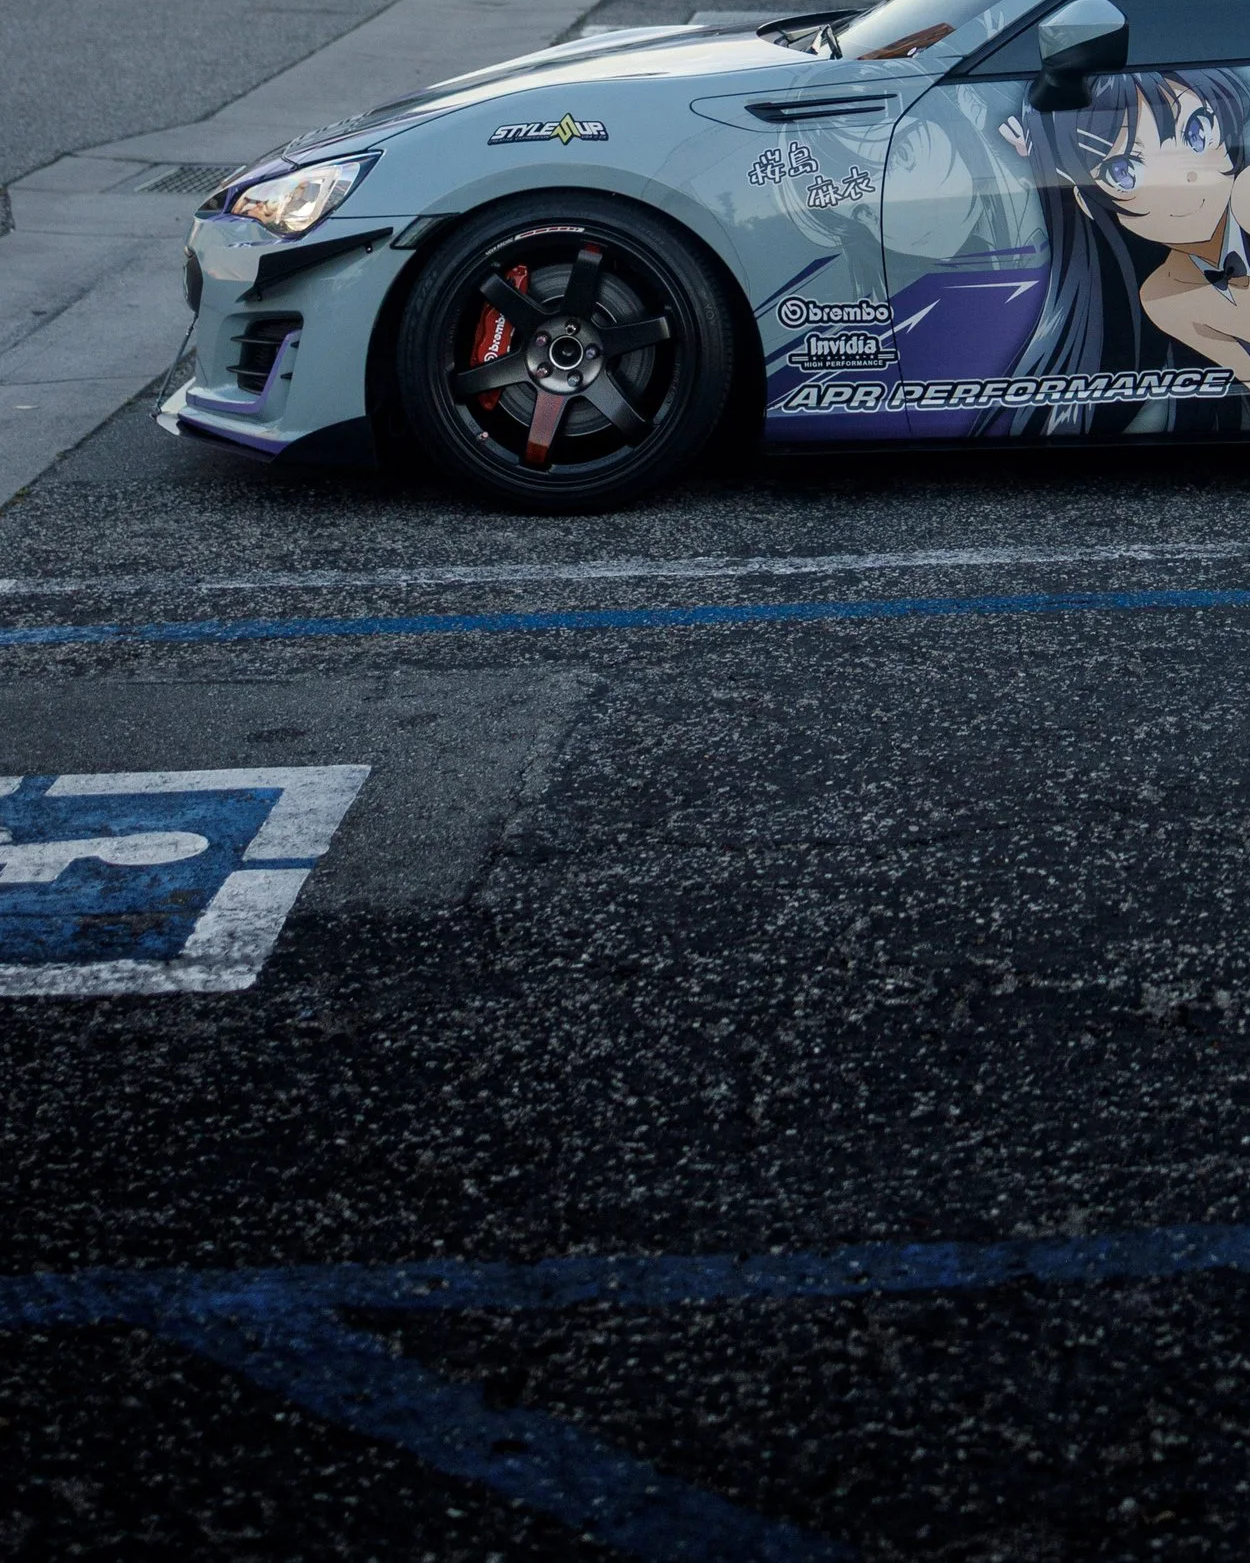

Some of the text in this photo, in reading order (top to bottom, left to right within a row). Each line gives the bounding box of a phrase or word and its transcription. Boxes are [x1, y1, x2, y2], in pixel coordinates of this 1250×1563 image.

[490, 121, 560, 140] STYLE
[749, 142, 818, 185] 桜島
[807, 166, 876, 208] 麻衣
[808, 303, 889, 321] brembo
[810, 336, 877, 355] Invidia
[826, 359, 884, 367] PERFORMANCE
[787, 372, 1231, 407] APR PERFORMANCE
